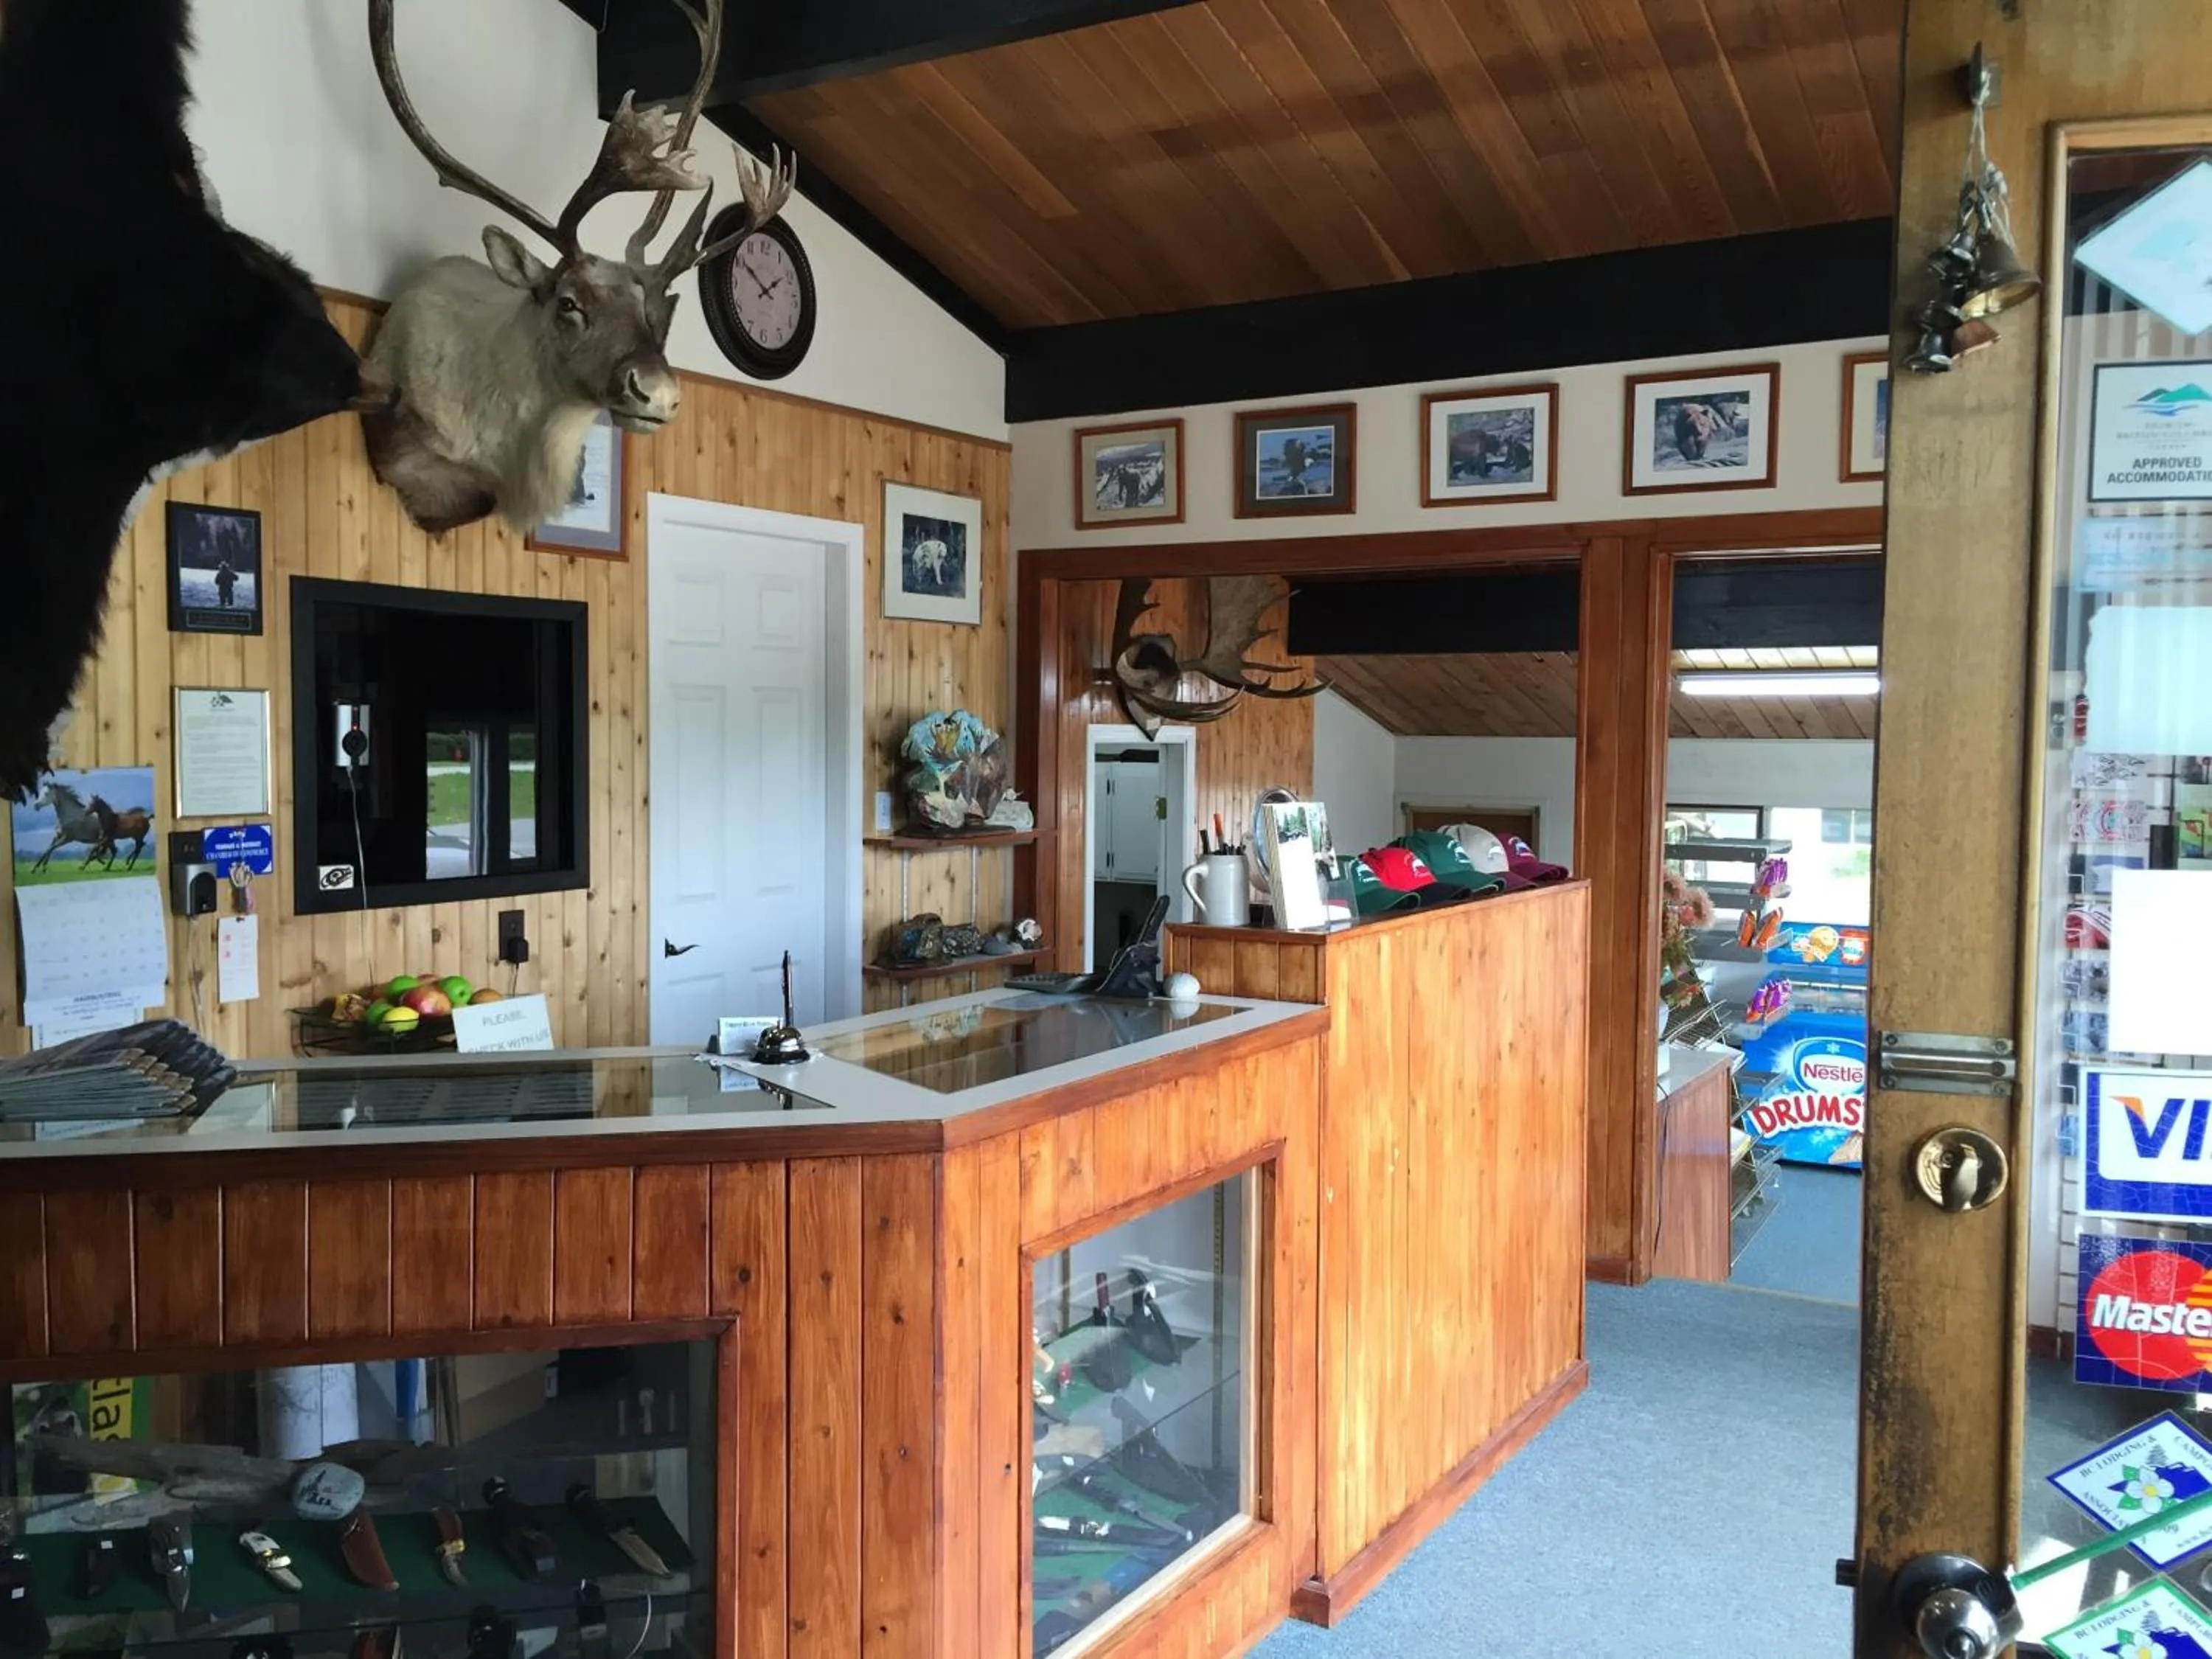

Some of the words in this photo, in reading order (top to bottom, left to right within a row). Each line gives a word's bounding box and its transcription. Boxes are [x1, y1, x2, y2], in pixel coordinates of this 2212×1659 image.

[759, 329, 768, 344] 6
[2132, 456, 2202, 470] APPROVED
[481, 1009, 526, 1026] PLEASE
[507, 1032, 535, 1048] WITH
[1752, 1094, 1865, 1134] DRUMS
[2108, 1095, 2212, 1161] VI
[2092, 1293, 2212, 1338] Maste
[2173, 1435, 2212, 1470] CAMPG
